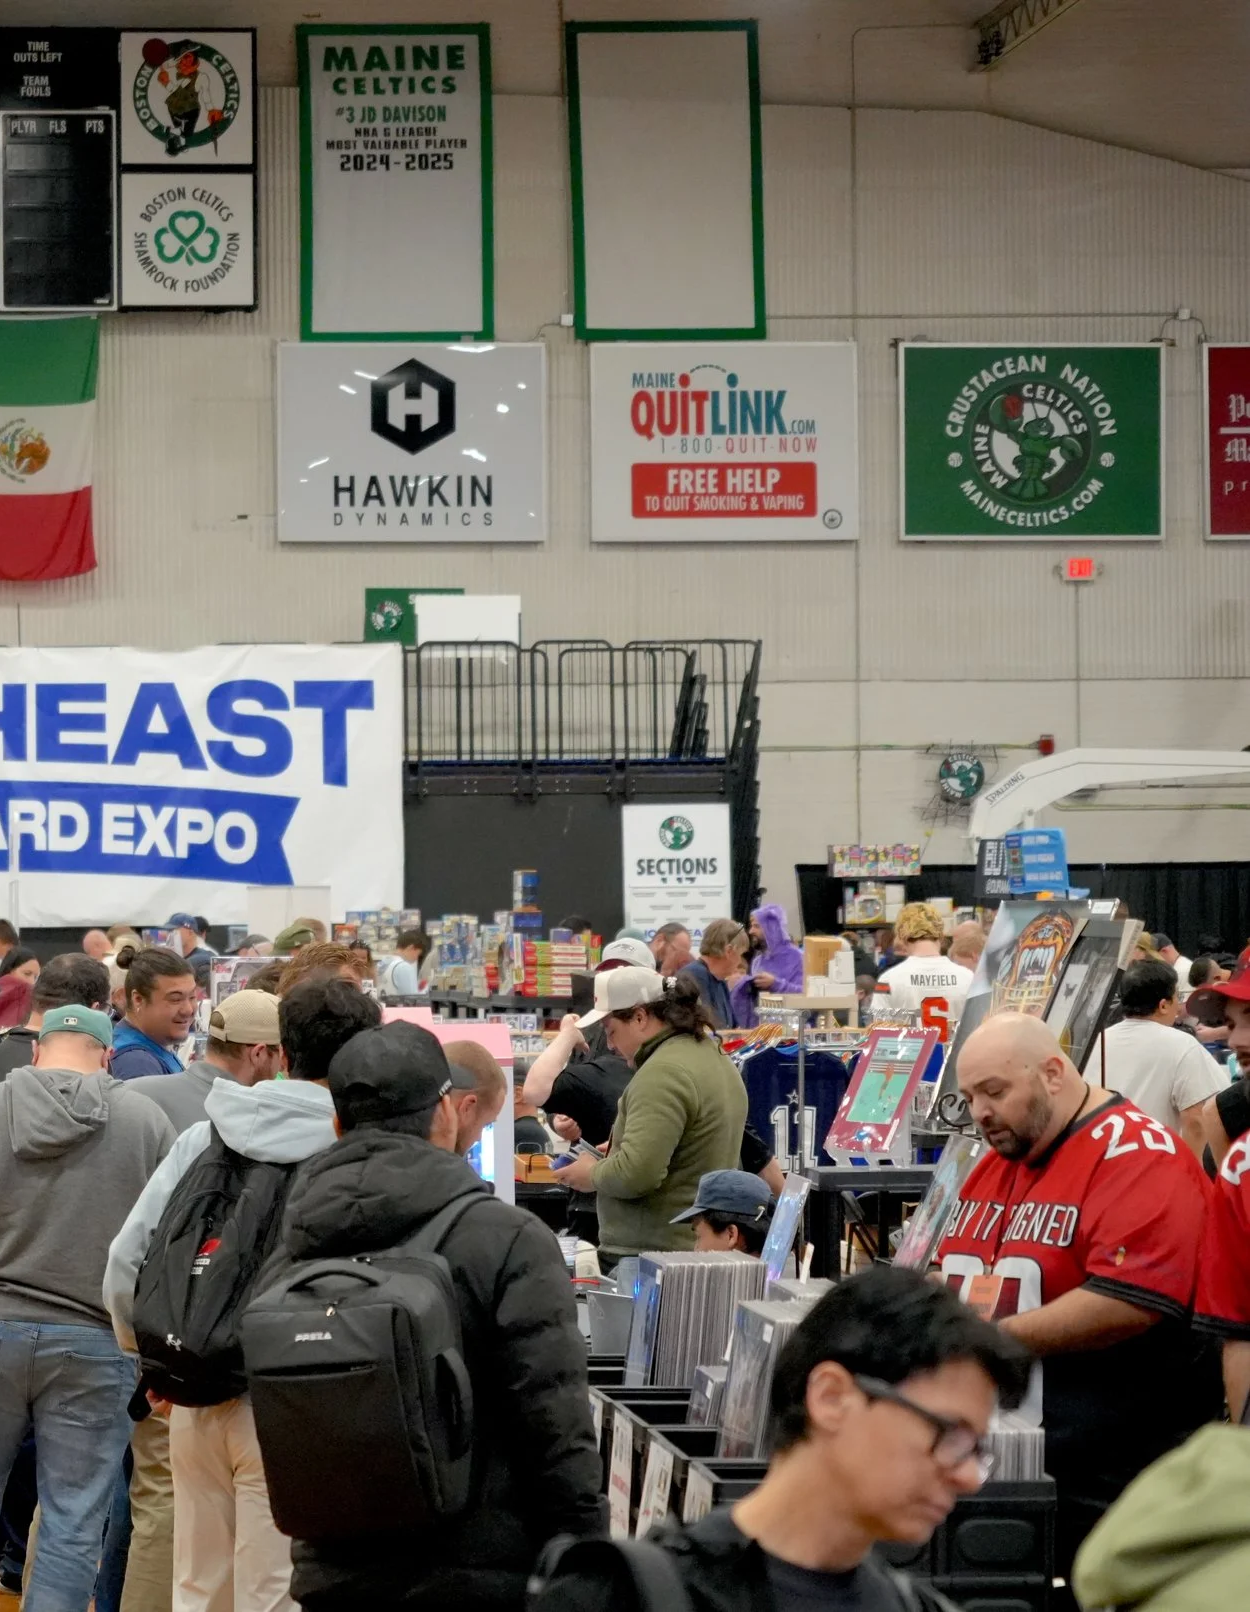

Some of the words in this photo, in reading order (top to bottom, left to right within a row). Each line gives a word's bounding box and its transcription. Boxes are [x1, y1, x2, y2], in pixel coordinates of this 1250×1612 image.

[27, 42, 49, 51] TIME
[13, 53, 38, 63] OUTS
[40, 53, 62, 62] LEFT
[323, 44, 466, 72] MAINE
[20, 86, 51, 97] FOULS
[23, 76, 49, 86] TEAM
[211, 54, 240, 121] CELTICS
[332, 76, 457, 95] CELTICS
[133, 66, 159, 131] BOSTON
[335, 106, 355, 124] #3
[360, 106, 377, 123] JD
[382, 105, 447, 123] DAVISON
[11, 121, 37, 133] PLYR
[49, 121, 67, 133] FLS
[85, 121, 104, 133] PTS
[354, 127, 379, 137] NBA
[383, 127, 391, 137] G
[395, 126, 438, 137] LEAGUE
[326, 140, 359, 150] MOST
[363, 140, 420, 150] VALUABLE
[425, 139, 467, 149] PLAYER
[139, 186, 186, 223] BOSTON
[192, 186, 233, 223] CELTICS
[134, 231, 179, 292] SHAMROCK
[184, 231, 240, 293] FOUNDATION
[632, 372, 676, 388] MAINE
[945, 355, 1047, 438] CRUSTACEAN
[1059, 363, 1117, 437] NATION
[1022, 383, 1088, 435] CELTICS
[973, 423, 1007, 489] MAINE
[333, 474, 493, 508] HAWKIN
[667, 468, 719, 494] FREE
[726, 468, 781, 494] HELP
[645, 496, 659, 511] TO
[664, 496, 690, 511] QUIT
[693, 495, 747, 511] SMOKING
[750, 495, 759, 510] &
[763, 494, 805, 511] VAPING
[960, 477, 1104, 528] MAINECELTICS.COM
[333, 512, 493, 527] DYNAMICS
[948, 753, 979, 765] CELTICS
[985, 771, 1025, 805] SPALDING
[102, 803, 258, 867] EXPO
[636, 857, 718, 876] SECTIONS
[910, 974, 957, 987] MAYFIELD
[1091, 1109, 1177, 1160] 23
[972, 1201, 1005, 1241] IT
[1002, 1201, 1079, 1248] SIGNED
